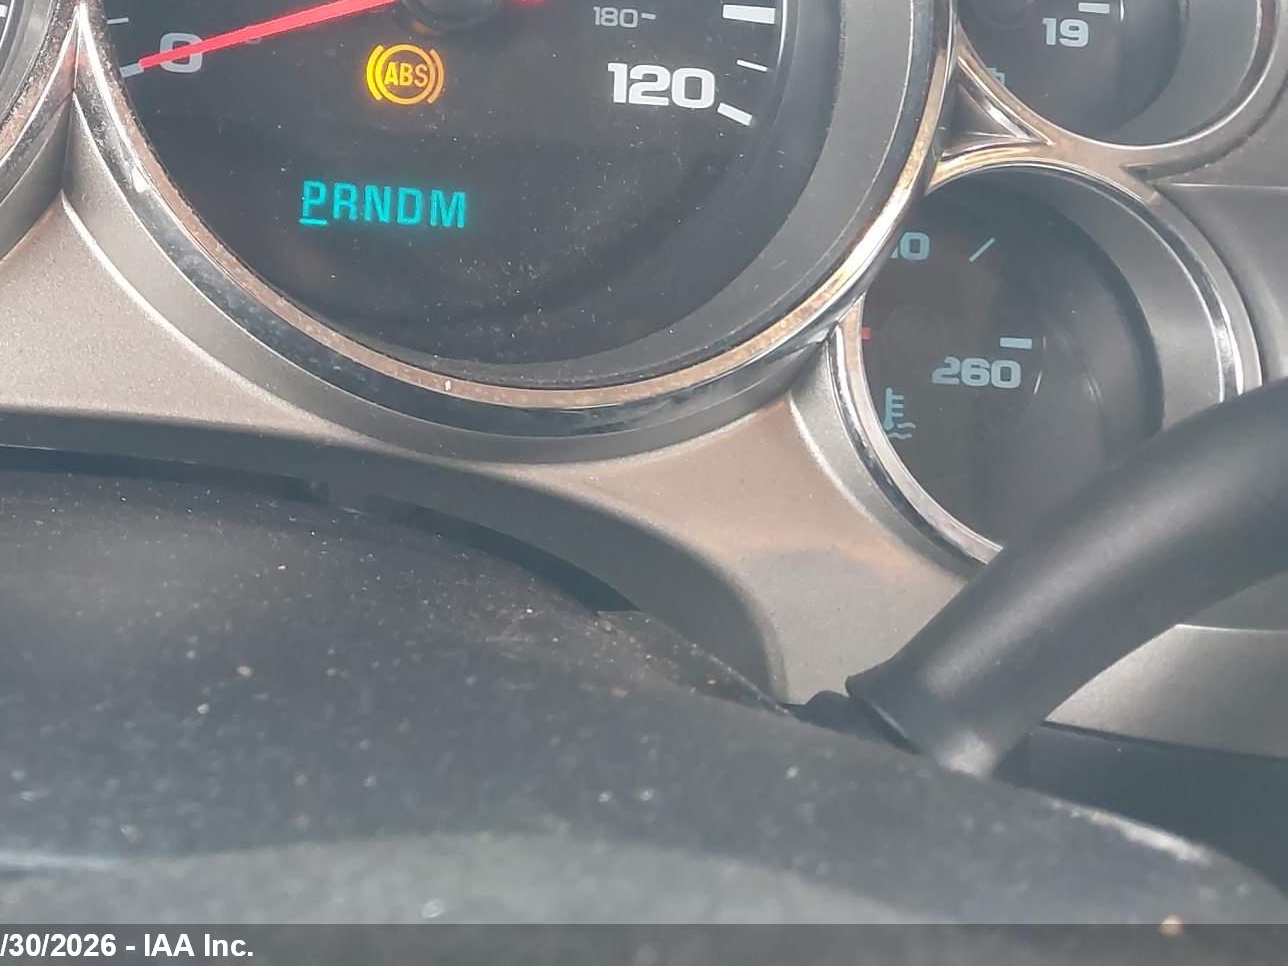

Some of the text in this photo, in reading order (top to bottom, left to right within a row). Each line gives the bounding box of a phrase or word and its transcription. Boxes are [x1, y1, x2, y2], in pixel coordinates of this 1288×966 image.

[594, 7, 639, 28] 180
[1042, 18, 1089, 47] 19
[159, 32, 204, 73] 0
[383, 62, 428, 87] ABS
[607, 62, 715, 109] 120
[300, 180, 467, 228] PRNDM
[891, 231, 931, 261] 0
[932, 357, 1022, 388] 260
